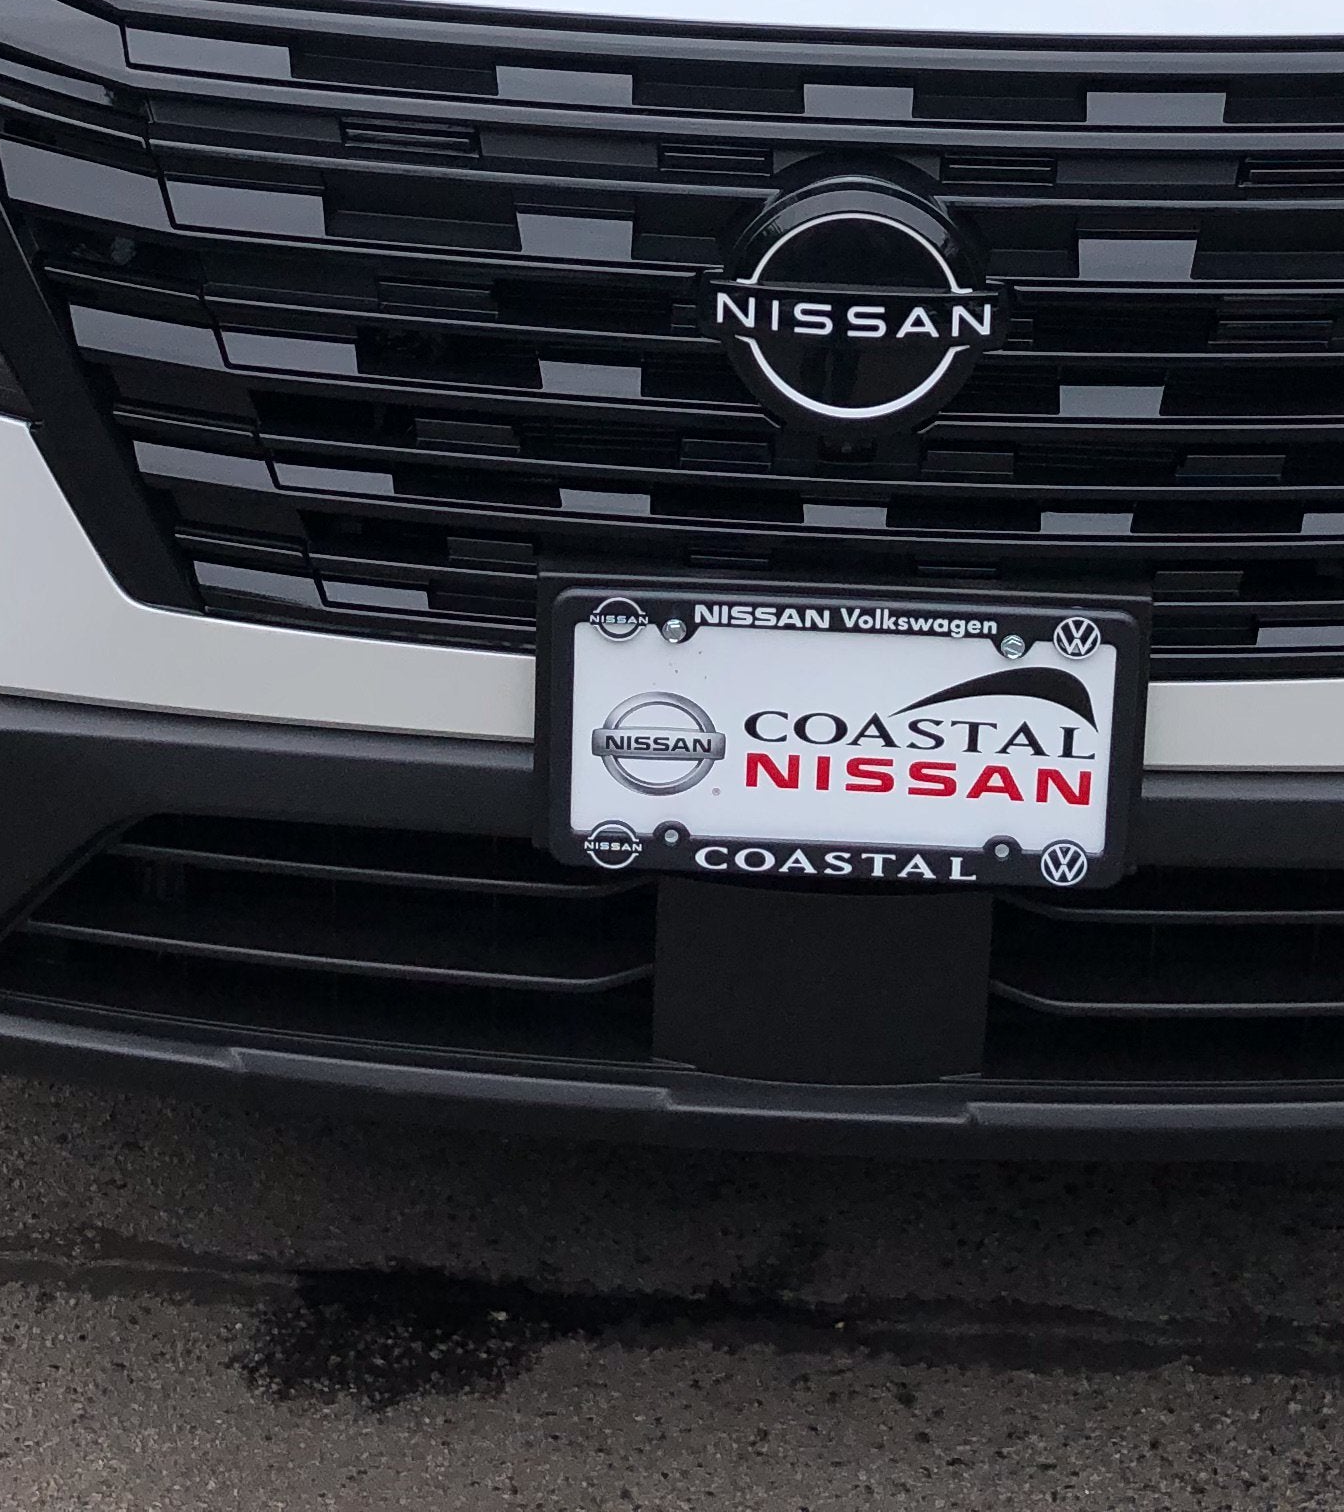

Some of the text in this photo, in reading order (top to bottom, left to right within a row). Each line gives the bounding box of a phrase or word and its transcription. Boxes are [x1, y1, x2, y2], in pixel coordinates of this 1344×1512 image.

[716, 292, 991, 338] NISSAN
[590, 614, 649, 625] NISSAN
[694, 604, 998, 638] NISSAN Volkswagen
[605, 735, 712, 754] NISSAN
[744, 710, 1096, 760] COASTAL
[745, 752, 1092, 806] NISSAN
[584, 840, 643, 852] NISSAN
[694, 846, 977, 881] COASTAL
